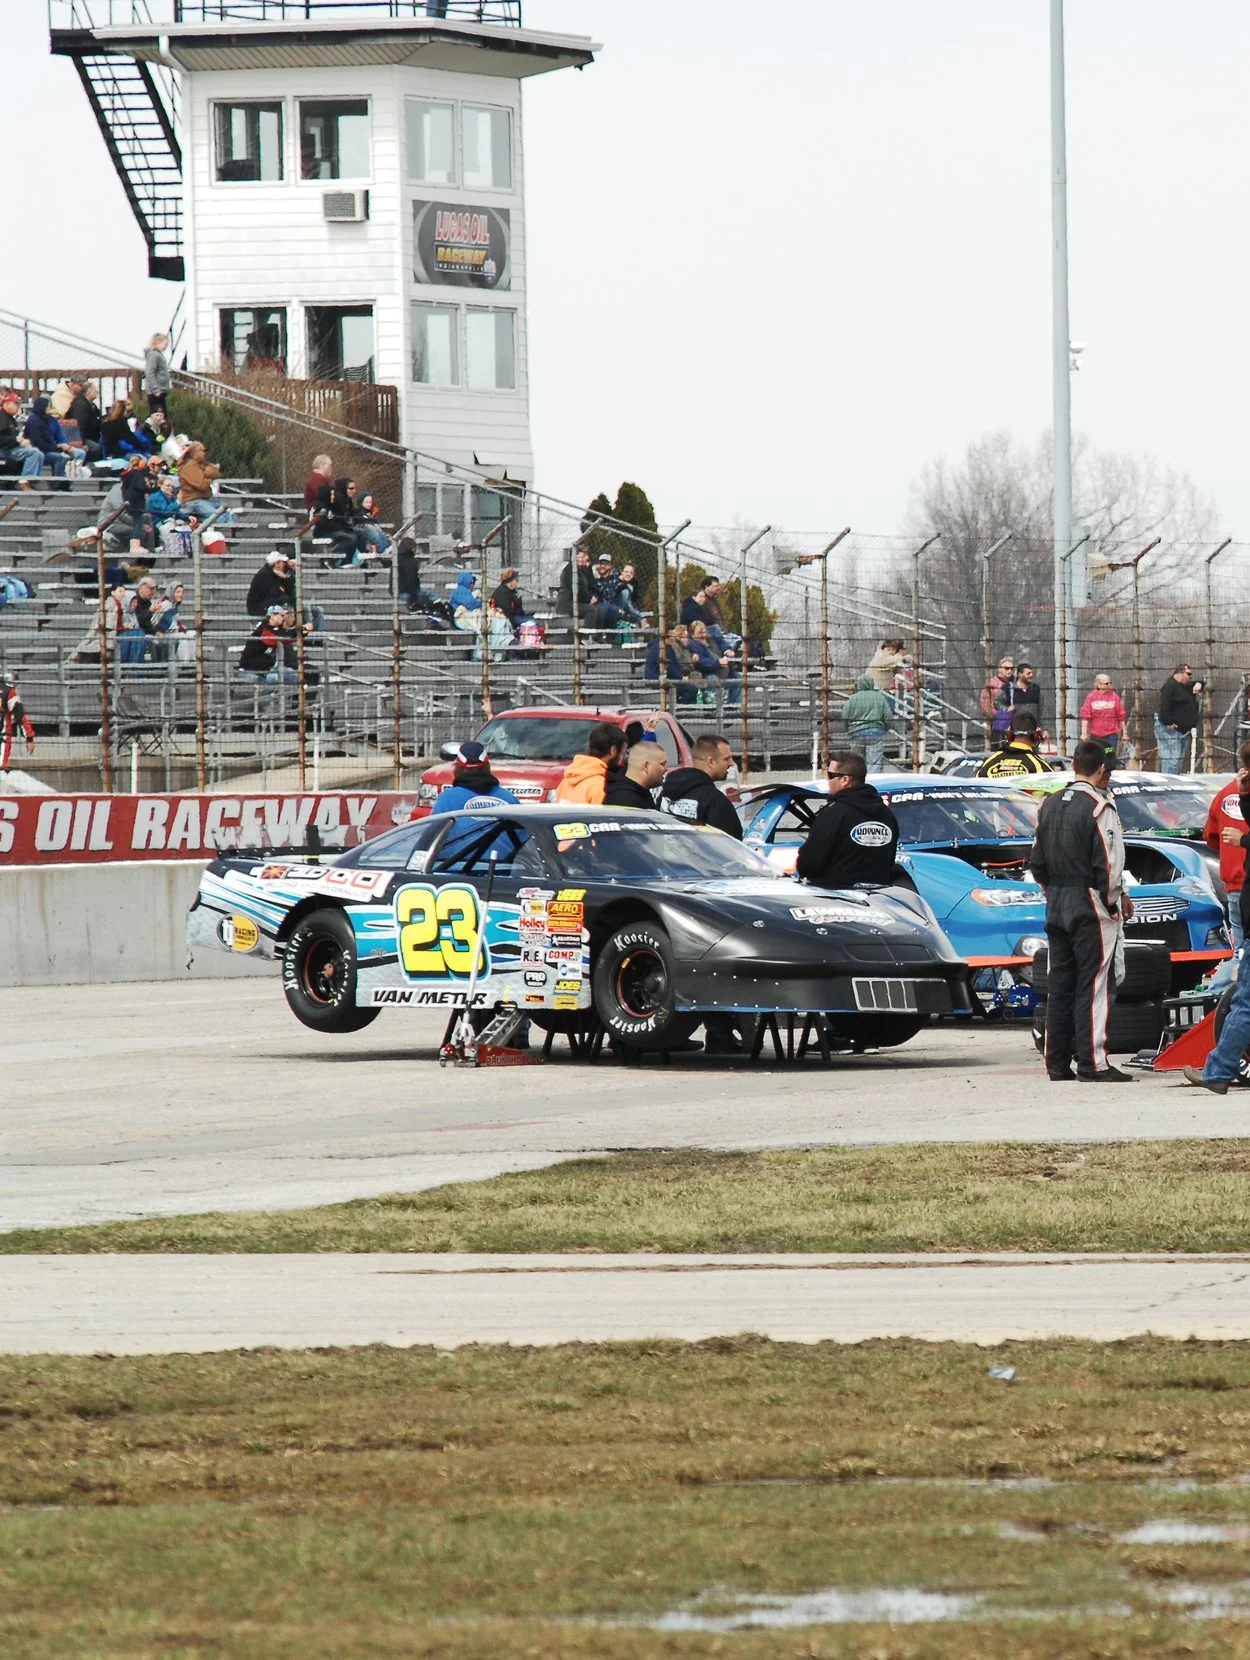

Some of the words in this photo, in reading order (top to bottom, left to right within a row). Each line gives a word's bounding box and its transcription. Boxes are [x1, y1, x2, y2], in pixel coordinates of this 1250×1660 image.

[434, 210, 470, 243] LUCAS
[470, 213, 490, 245] OIL
[436, 247, 487, 265] RACEWAY
[34, 799, 114, 851] OIL
[550, 903, 579, 914] AERO
[520, 916, 546, 931] Holley
[1126, 913, 1178, 924] SION
[395, 886, 489, 979] 23
[612, 930, 660, 953] Hoosier
[525, 971, 546, 982] PRO
[373, 989, 414, 1004] VAN
[609, 1014, 657, 1036] Hoosier
